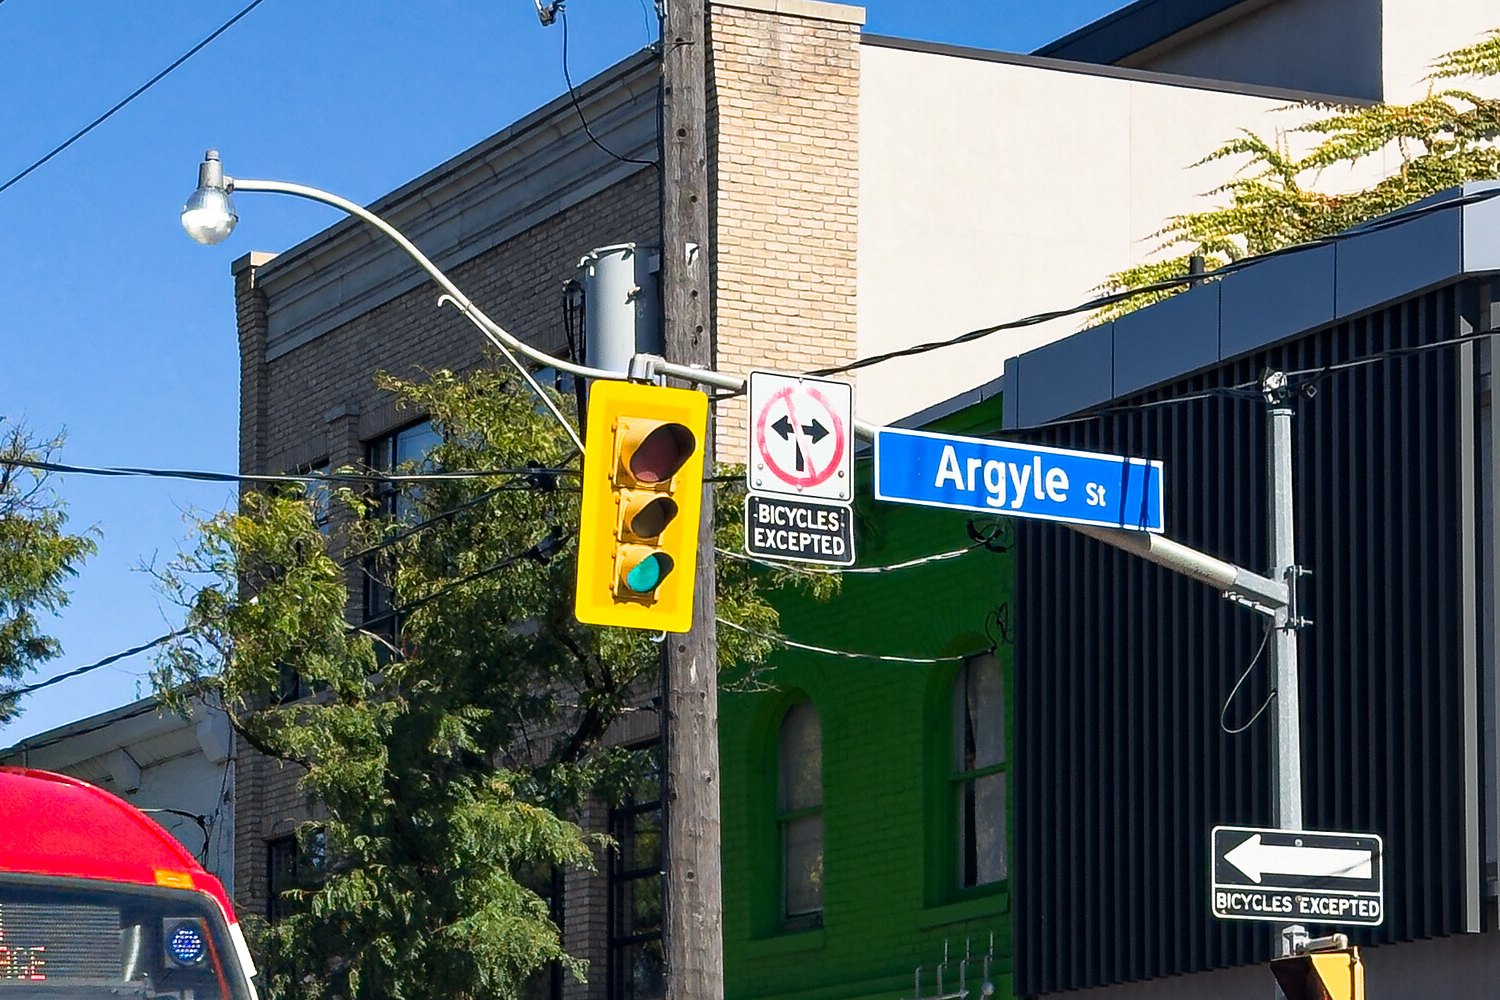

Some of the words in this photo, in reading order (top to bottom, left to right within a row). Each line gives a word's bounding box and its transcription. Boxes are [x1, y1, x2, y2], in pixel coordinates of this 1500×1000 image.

[934, 445, 1070, 509] Argyle
[1086, 482, 1107, 507] St
[758, 503, 840, 532] BICYCLES
[754, 528, 845, 556] EXCEPTED
[1216, 892, 1293, 913] BICYCLES
[1299, 896, 1380, 917] EXCEPTED
